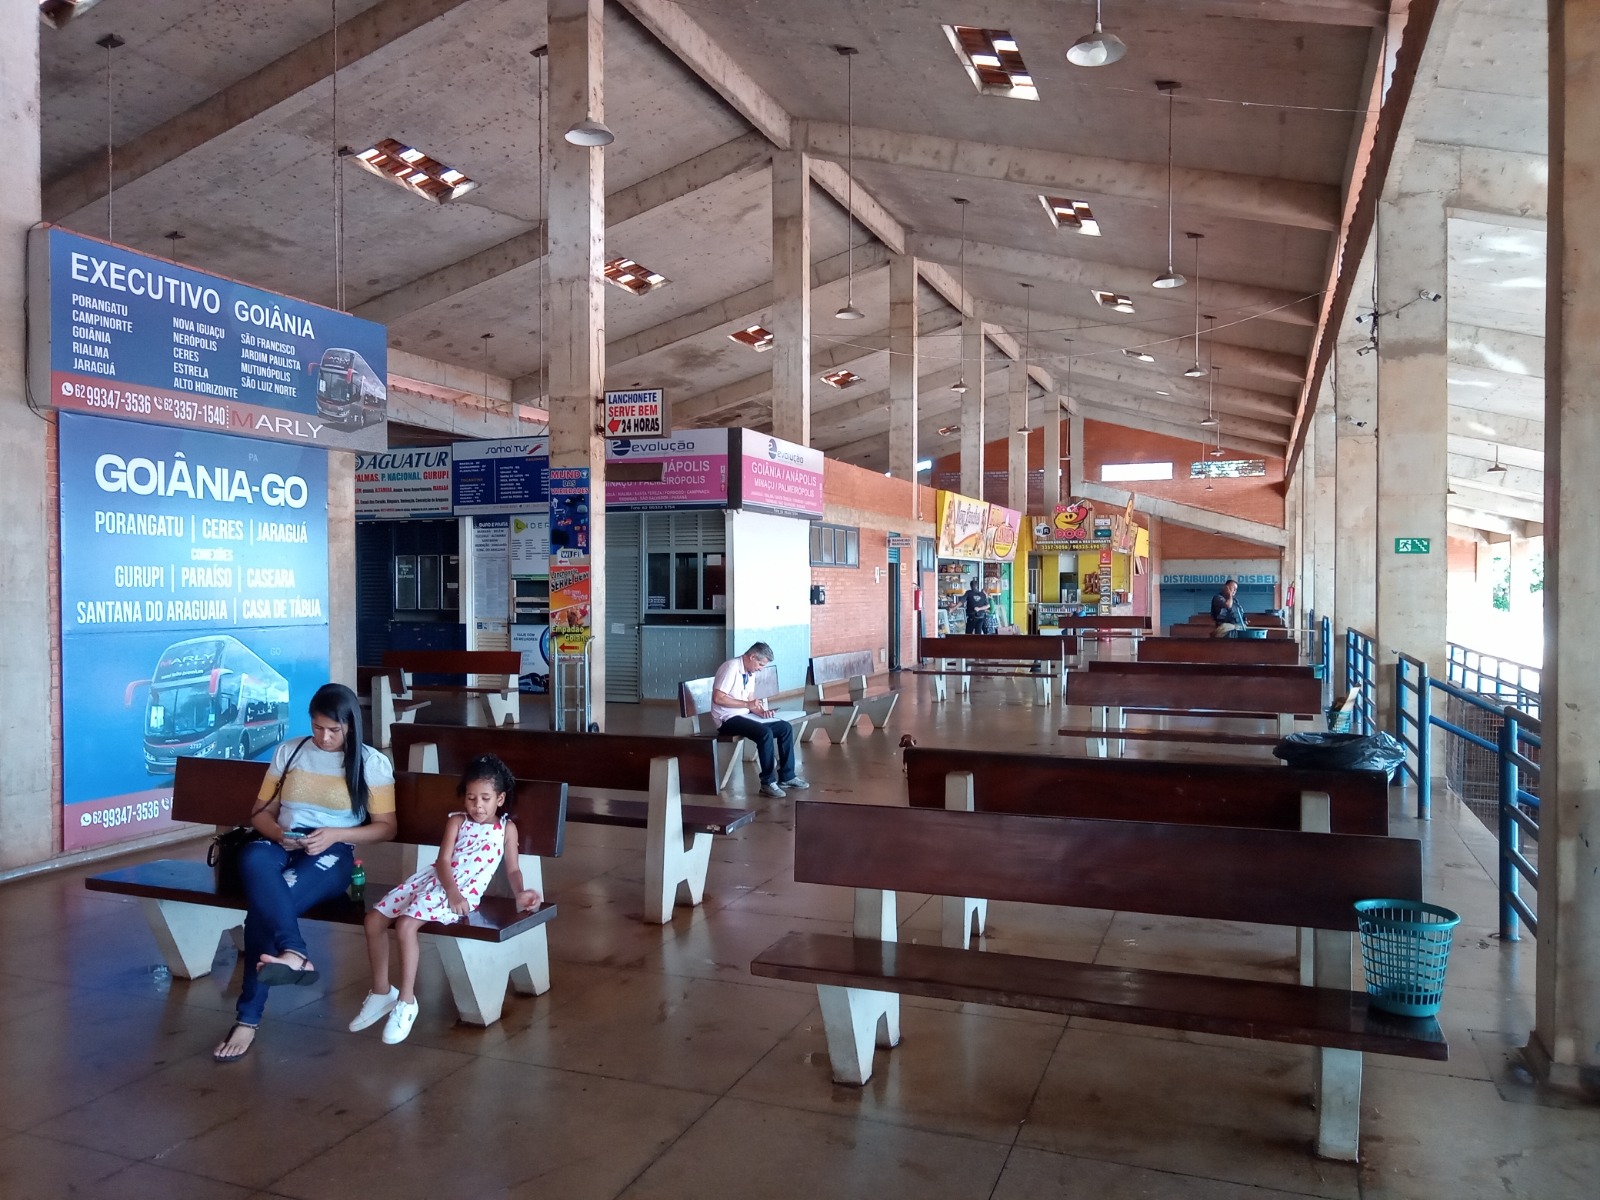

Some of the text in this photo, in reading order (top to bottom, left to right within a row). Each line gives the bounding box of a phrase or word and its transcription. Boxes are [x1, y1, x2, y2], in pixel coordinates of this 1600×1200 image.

[71, 252, 315, 340] EXECUTIVO GOIÂNIA
[71, 293, 129, 317] PORANGATU
[72, 309, 134, 333] CAMPINORTE
[172, 317, 225, 339] NOVA IGUAÇU
[72, 324, 112, 345] GOIÂNIA
[173, 331, 218, 352] NERÓPOLIS
[240, 332, 296, 356] SÃO FRANCISCO
[72, 341, 110, 360] RIALMA
[173, 347, 200, 363] CERES
[240, 348, 302, 371] JARDIM PAULISTA
[72, 357, 116, 376] JARAGUÁ
[173, 362, 209, 379] ESTRELA
[240, 362, 291, 383] MUTUNÓPOLIS
[173, 377, 239, 399] ALTO HORIZONTE
[241, 377, 297, 398] SÃO LUIZ NORTE
[608, 392, 657, 405] LANCHONETE
[74, 383, 86, 399] 62
[86, 385, 151, 415] 99347-3536
[173, 399, 226, 426] 3357-1540
[231, 410, 324, 439] MARLY
[608, 404, 658, 418] SERVE BEM
[621, 417, 660, 434] 24 HORAS
[631, 440, 695, 453] evolução
[95, 451, 308, 509] GOIÂNIA-GO
[423, 470, 449, 480] GURUPI
[751, 461, 781, 479] GOIÂNIA
[785, 470, 817, 487] ANÁPOLIS
[754, 477, 775, 491] MINAÇU
[778, 482, 815, 498] PALMEIRÓPOLIS
[95, 511, 308, 544] PORANGATU CERES JARAGUÁ
[1055, 528, 1087, 539] DOG
[115, 562, 296, 589] GURUPI PARAÍSO CASEARA
[1163, 574, 1278, 583] DISTRIBUIDORA DISBEL
[77, 596, 322, 625] SANTANA DO ARAGUAIA CASA DE TÁBUA
[92, 798, 160, 829] 62 99347-3536
